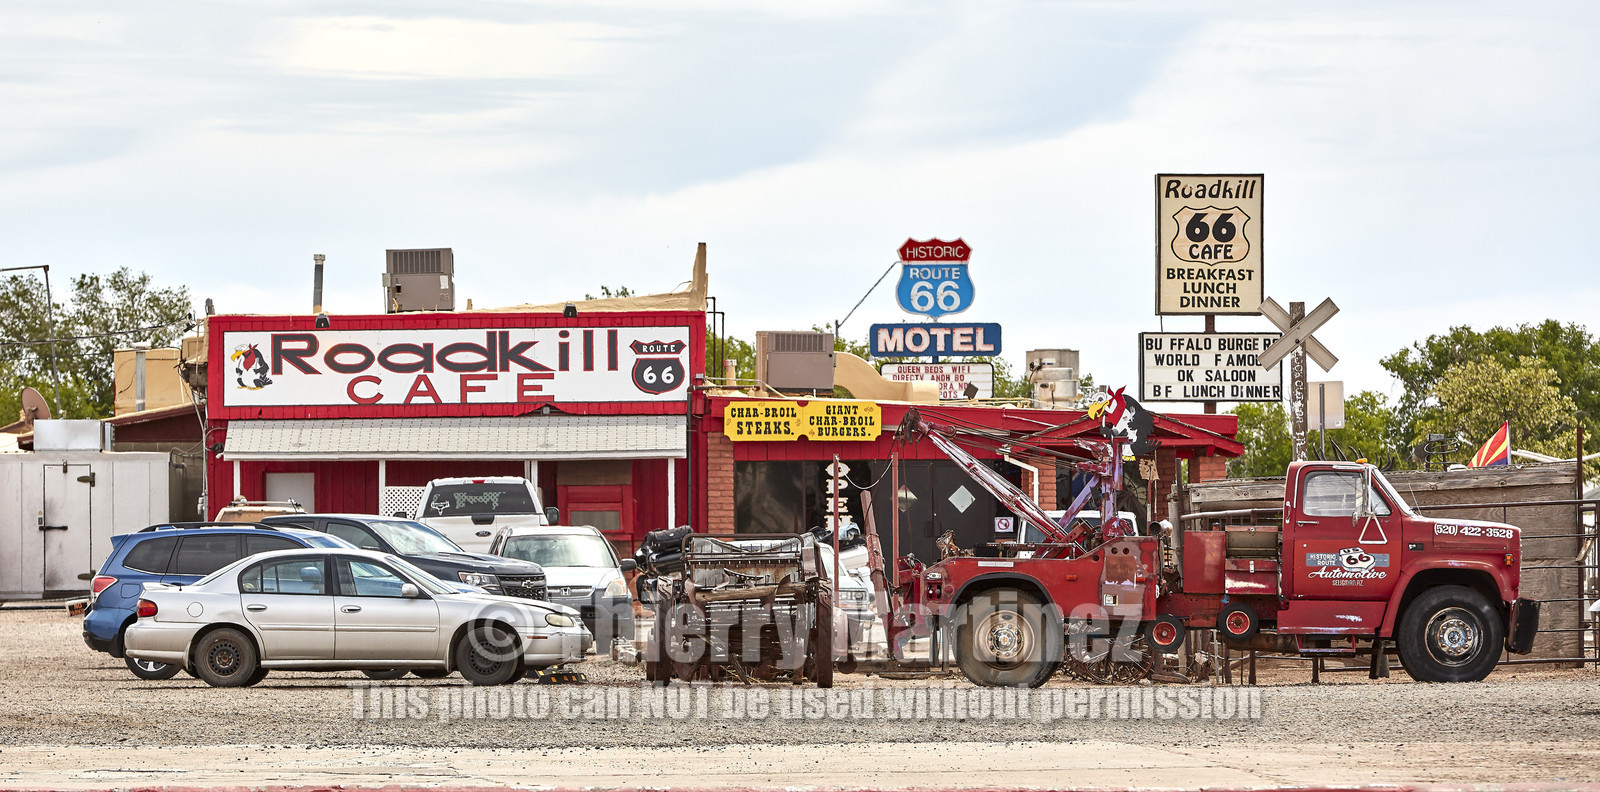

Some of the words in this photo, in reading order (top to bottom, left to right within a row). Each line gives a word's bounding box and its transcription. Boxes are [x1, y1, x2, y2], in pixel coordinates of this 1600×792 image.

[1164, 180, 1257, 199] Roadkill
[1186, 213, 1236, 242] 66
[906, 246, 964, 259] HISTORIC
[1189, 244, 1233, 259] CAFE
[909, 267, 961, 280] ROUTE
[1166, 268, 1255, 281] BREAKFAST
[1183, 282, 1237, 294] LUNCH
[910, 281, 961, 312] 66
[1180, 296, 1241, 308] DINNER
[877, 327, 994, 353] MOTEL
[271, 329, 619, 376] Roadkill
[642, 344, 676, 353] ROUTE
[1154, 353, 1200, 366] WORLD
[643, 365, 675, 384] 66
[897, 365, 921, 374] QUEEN
[924, 365, 944, 374] BEDS
[951, 365, 971, 374] WIFI
[1177, 369, 1194, 382] OK
[1205, 369, 1256, 382] SALOON
[346, 374, 556, 405] CAFE
[1183, 384, 1226, 398] LUNCH
[1231, 384, 1281, 398] DINNER
[730, 407, 797, 418] CHAR-BROIL
[825, 405, 859, 415] GIANT
[809, 416, 875, 426] CHAR-BROIL
[736, 421, 795, 436] STEAKS.
[817, 426, 872, 437] BURGERS.
[1434, 522, 1458, 536] (520)
[1346, 553, 1371, 565] 66
[1308, 565, 1387, 579] Automotive
